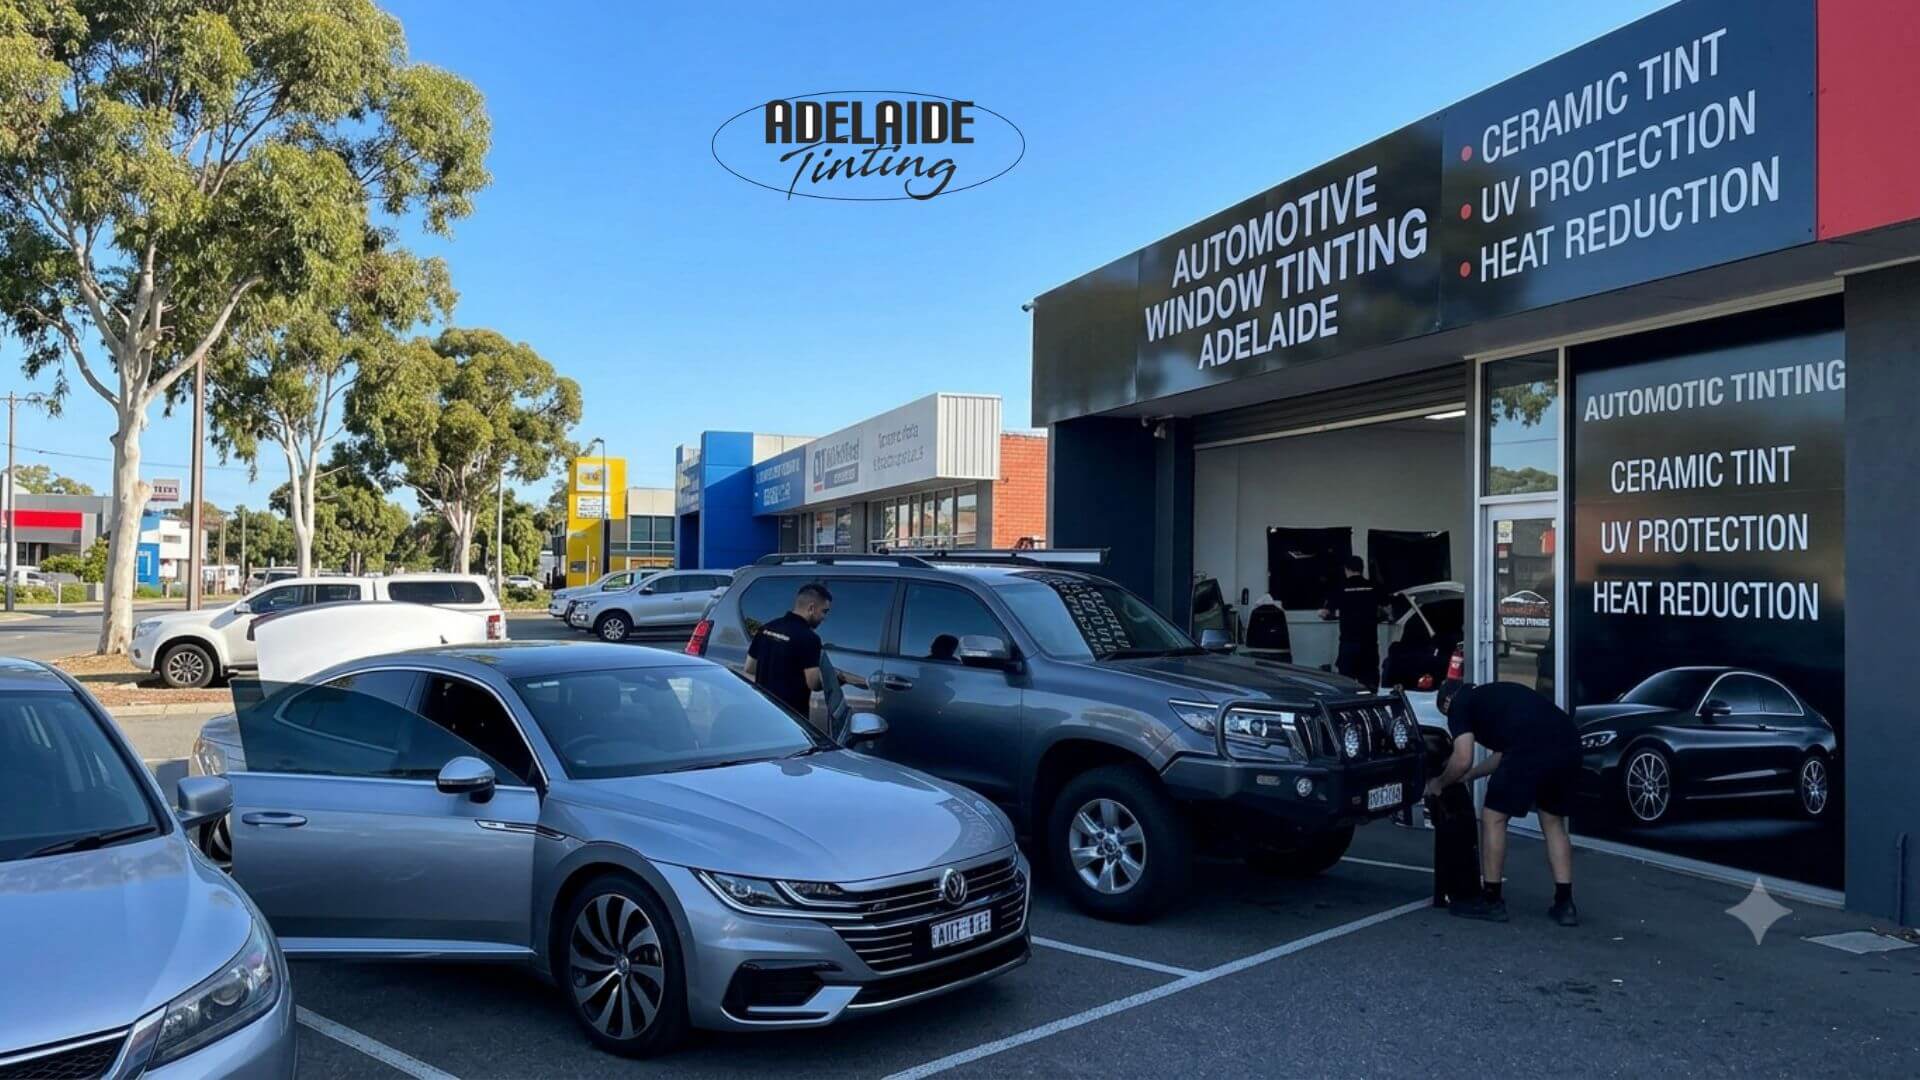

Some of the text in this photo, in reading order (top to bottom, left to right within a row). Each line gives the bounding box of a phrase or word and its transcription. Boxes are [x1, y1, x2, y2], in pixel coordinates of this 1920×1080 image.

[1481, 27, 1727, 164] CERAMIC TINT
[1481, 89, 1756, 224] UV PROTECTION
[1172, 165, 1378, 288] AUTOMOTIVE
[1480, 155, 1780, 282] HEAT REDUCTION
[1144, 207, 1428, 342] WINDOW TINTING
[1198, 294, 1339, 370] ADELAIDE
[1584, 359, 1846, 422] AUTOMOTIC TINTING
[1611, 445, 1796, 493] CERAMIC TINT
[1601, 513, 1808, 554] UV PROTECTION
[1593, 581, 1819, 621] HEAT REDUCTION
